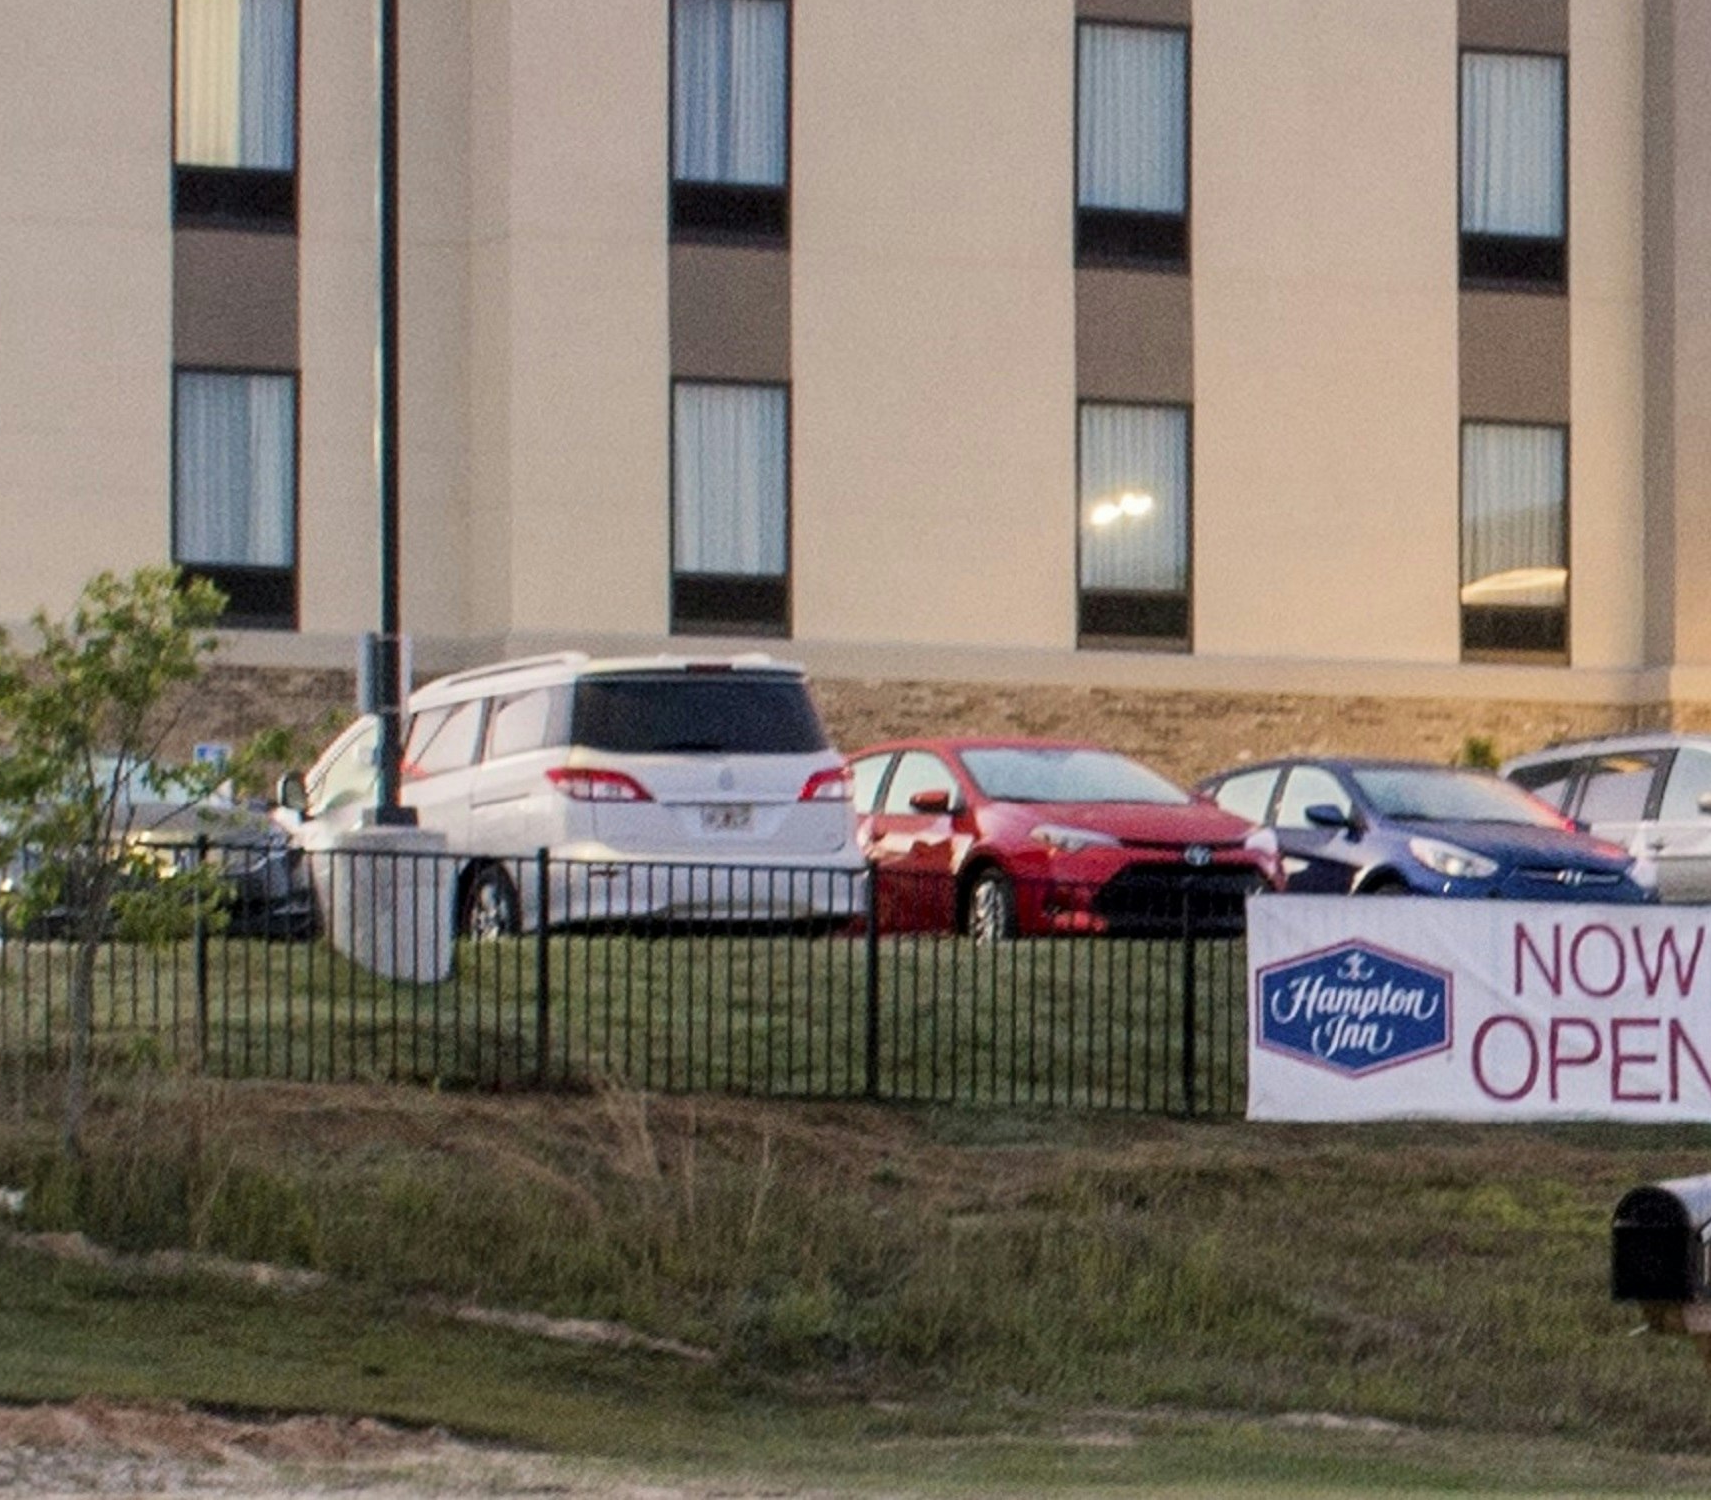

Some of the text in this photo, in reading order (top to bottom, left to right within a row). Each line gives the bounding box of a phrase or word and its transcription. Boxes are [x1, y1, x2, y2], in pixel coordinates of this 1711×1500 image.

[1514, 923, 1706, 997] NOW
[1271, 975, 1439, 1024] Hampton
[1311, 1014, 1394, 1058] Inn
